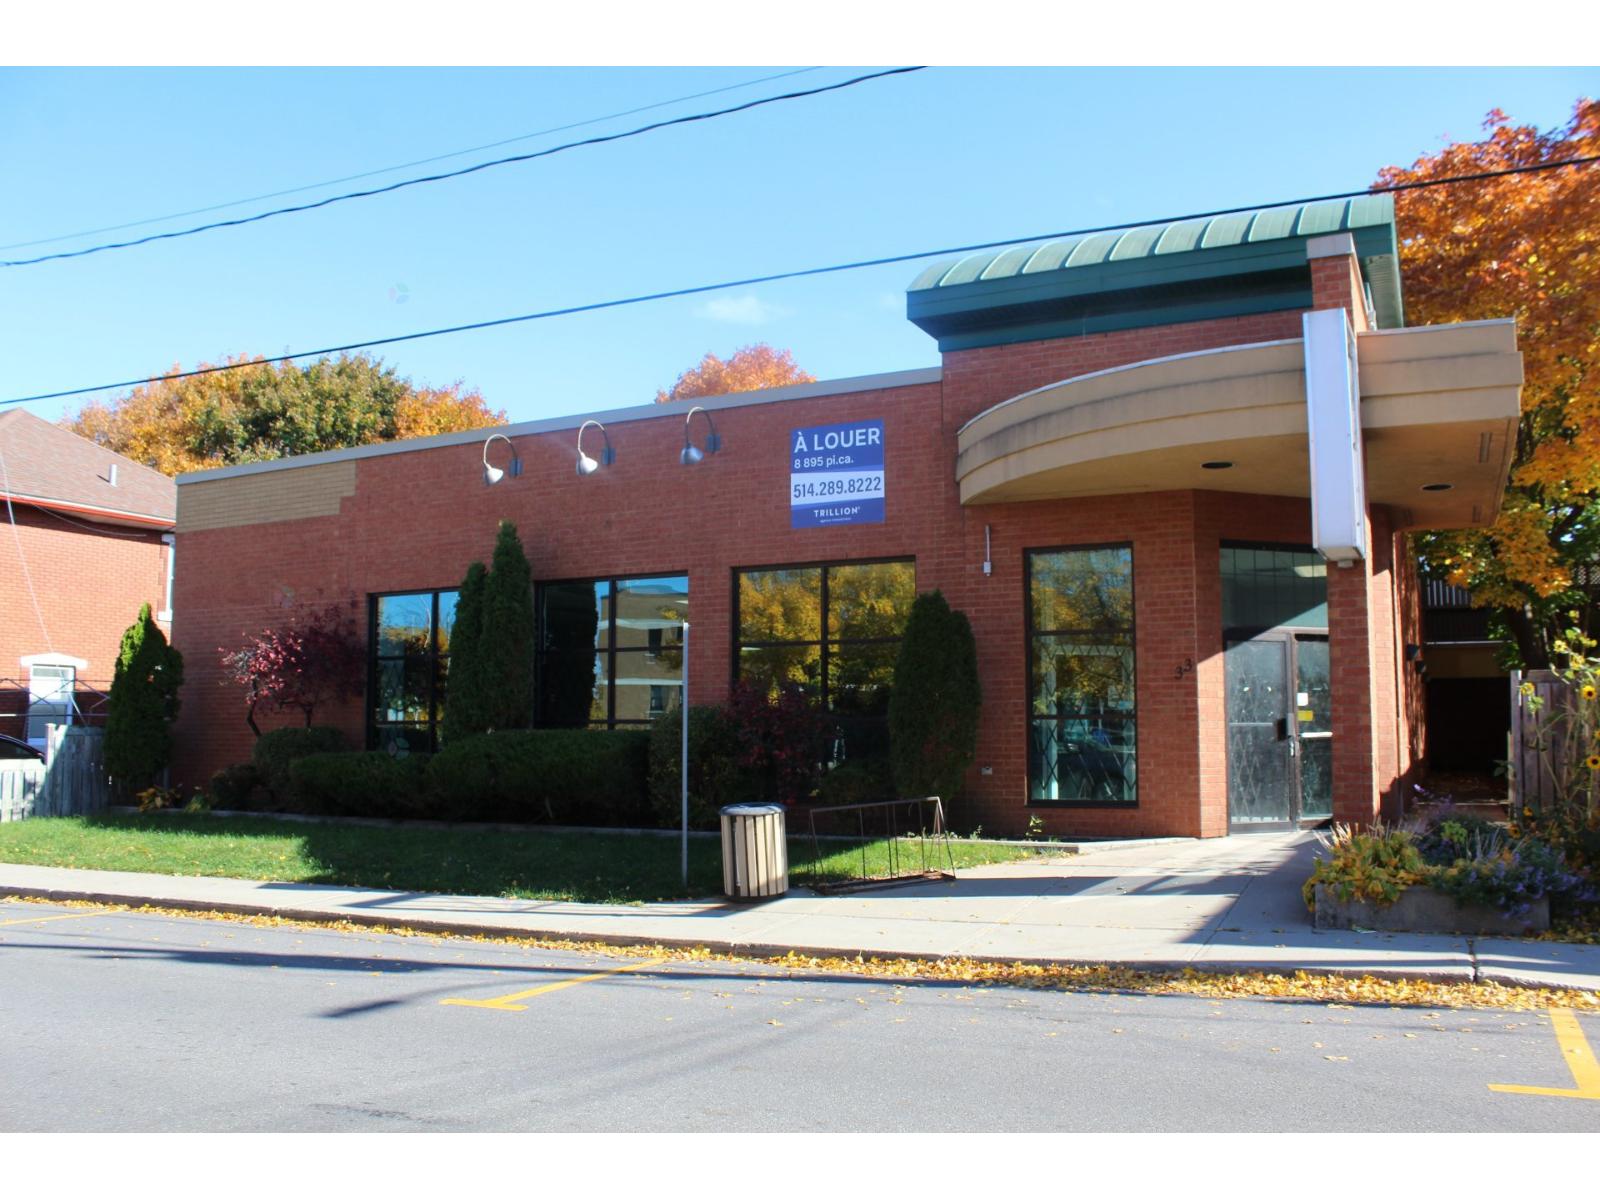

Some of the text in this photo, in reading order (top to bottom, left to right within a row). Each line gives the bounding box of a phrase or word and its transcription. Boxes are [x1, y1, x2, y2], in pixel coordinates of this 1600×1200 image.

[794, 427, 880, 453] À LOUER
[794, 454, 854, 469] 8 895 pi.ca.
[793, 476, 882, 499] 514.289.8222
[814, 506, 858, 518] TRILLION
